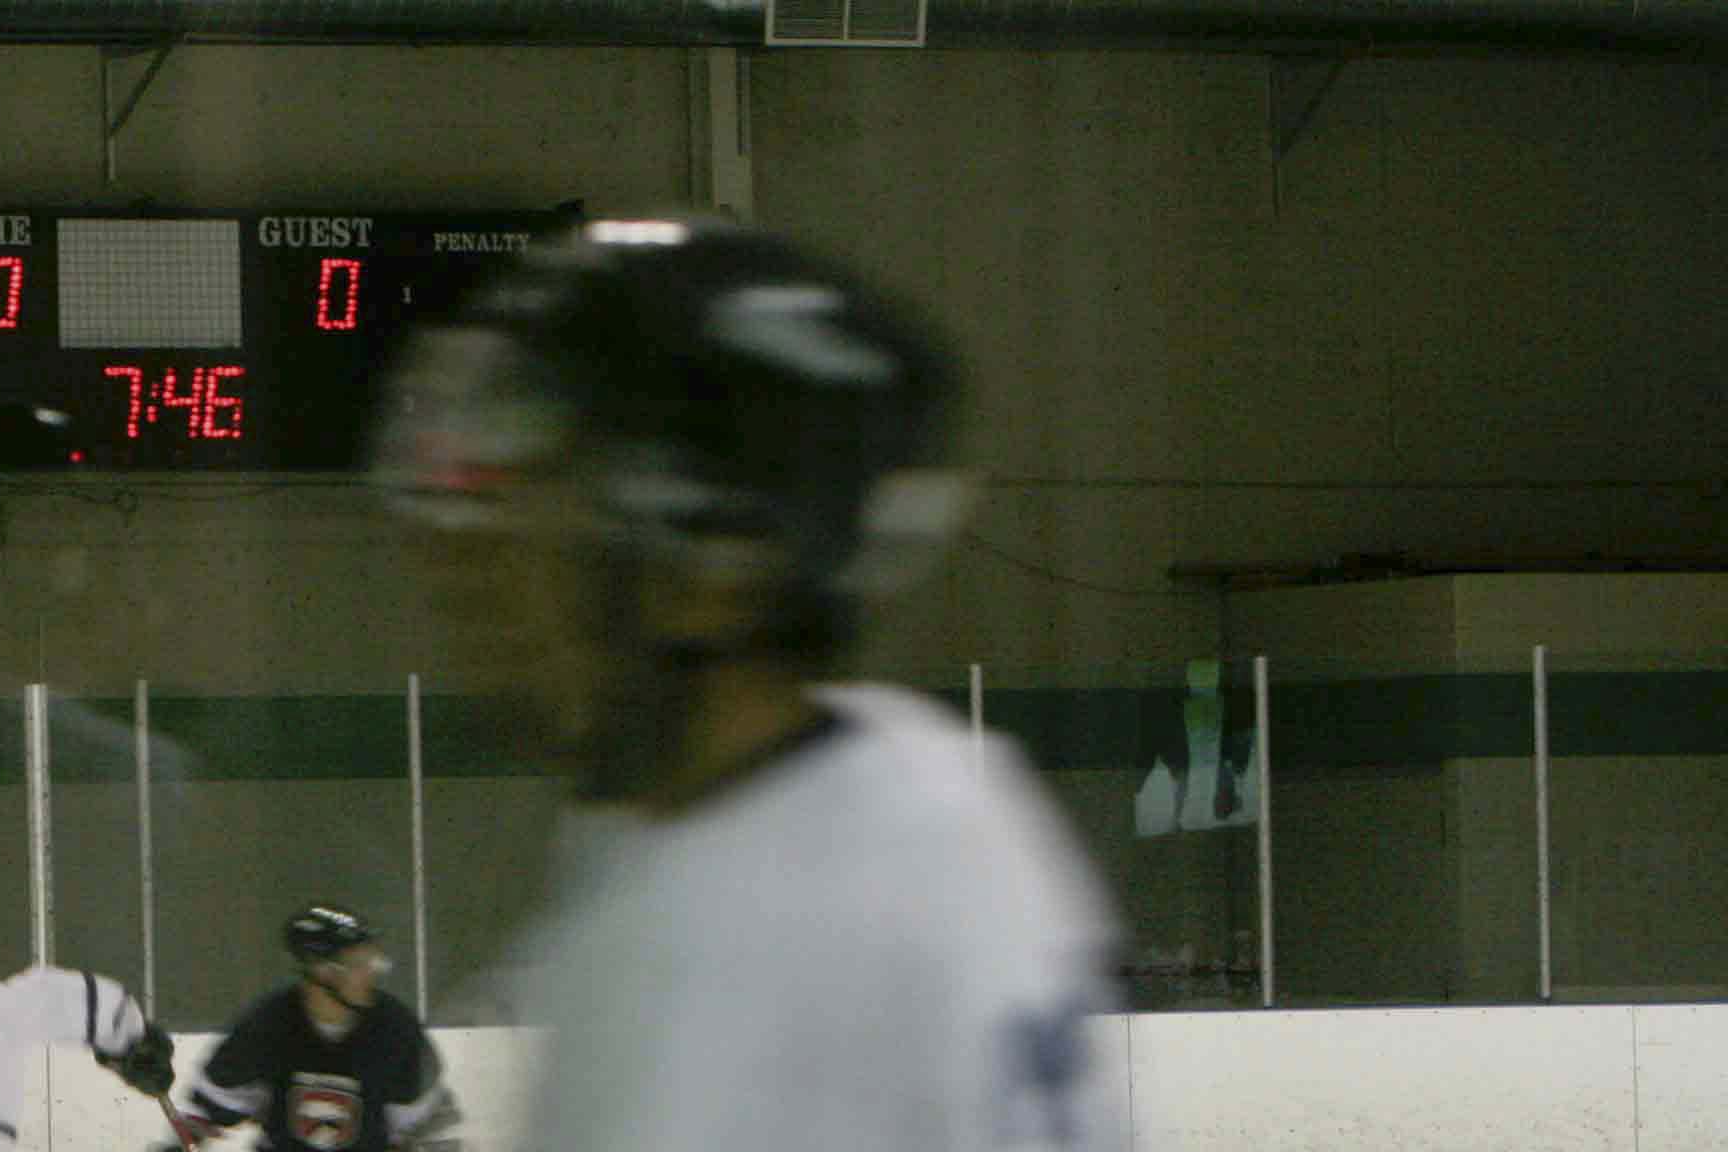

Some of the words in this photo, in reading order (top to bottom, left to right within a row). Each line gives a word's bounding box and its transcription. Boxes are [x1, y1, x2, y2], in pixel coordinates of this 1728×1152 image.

[257, 217, 373, 248] GUEST
[433, 232, 532, 252] PENALTY
[316, 257, 362, 331] 0
[402, 285, 413, 304] 1
[102, 366, 248, 439] 7:46
